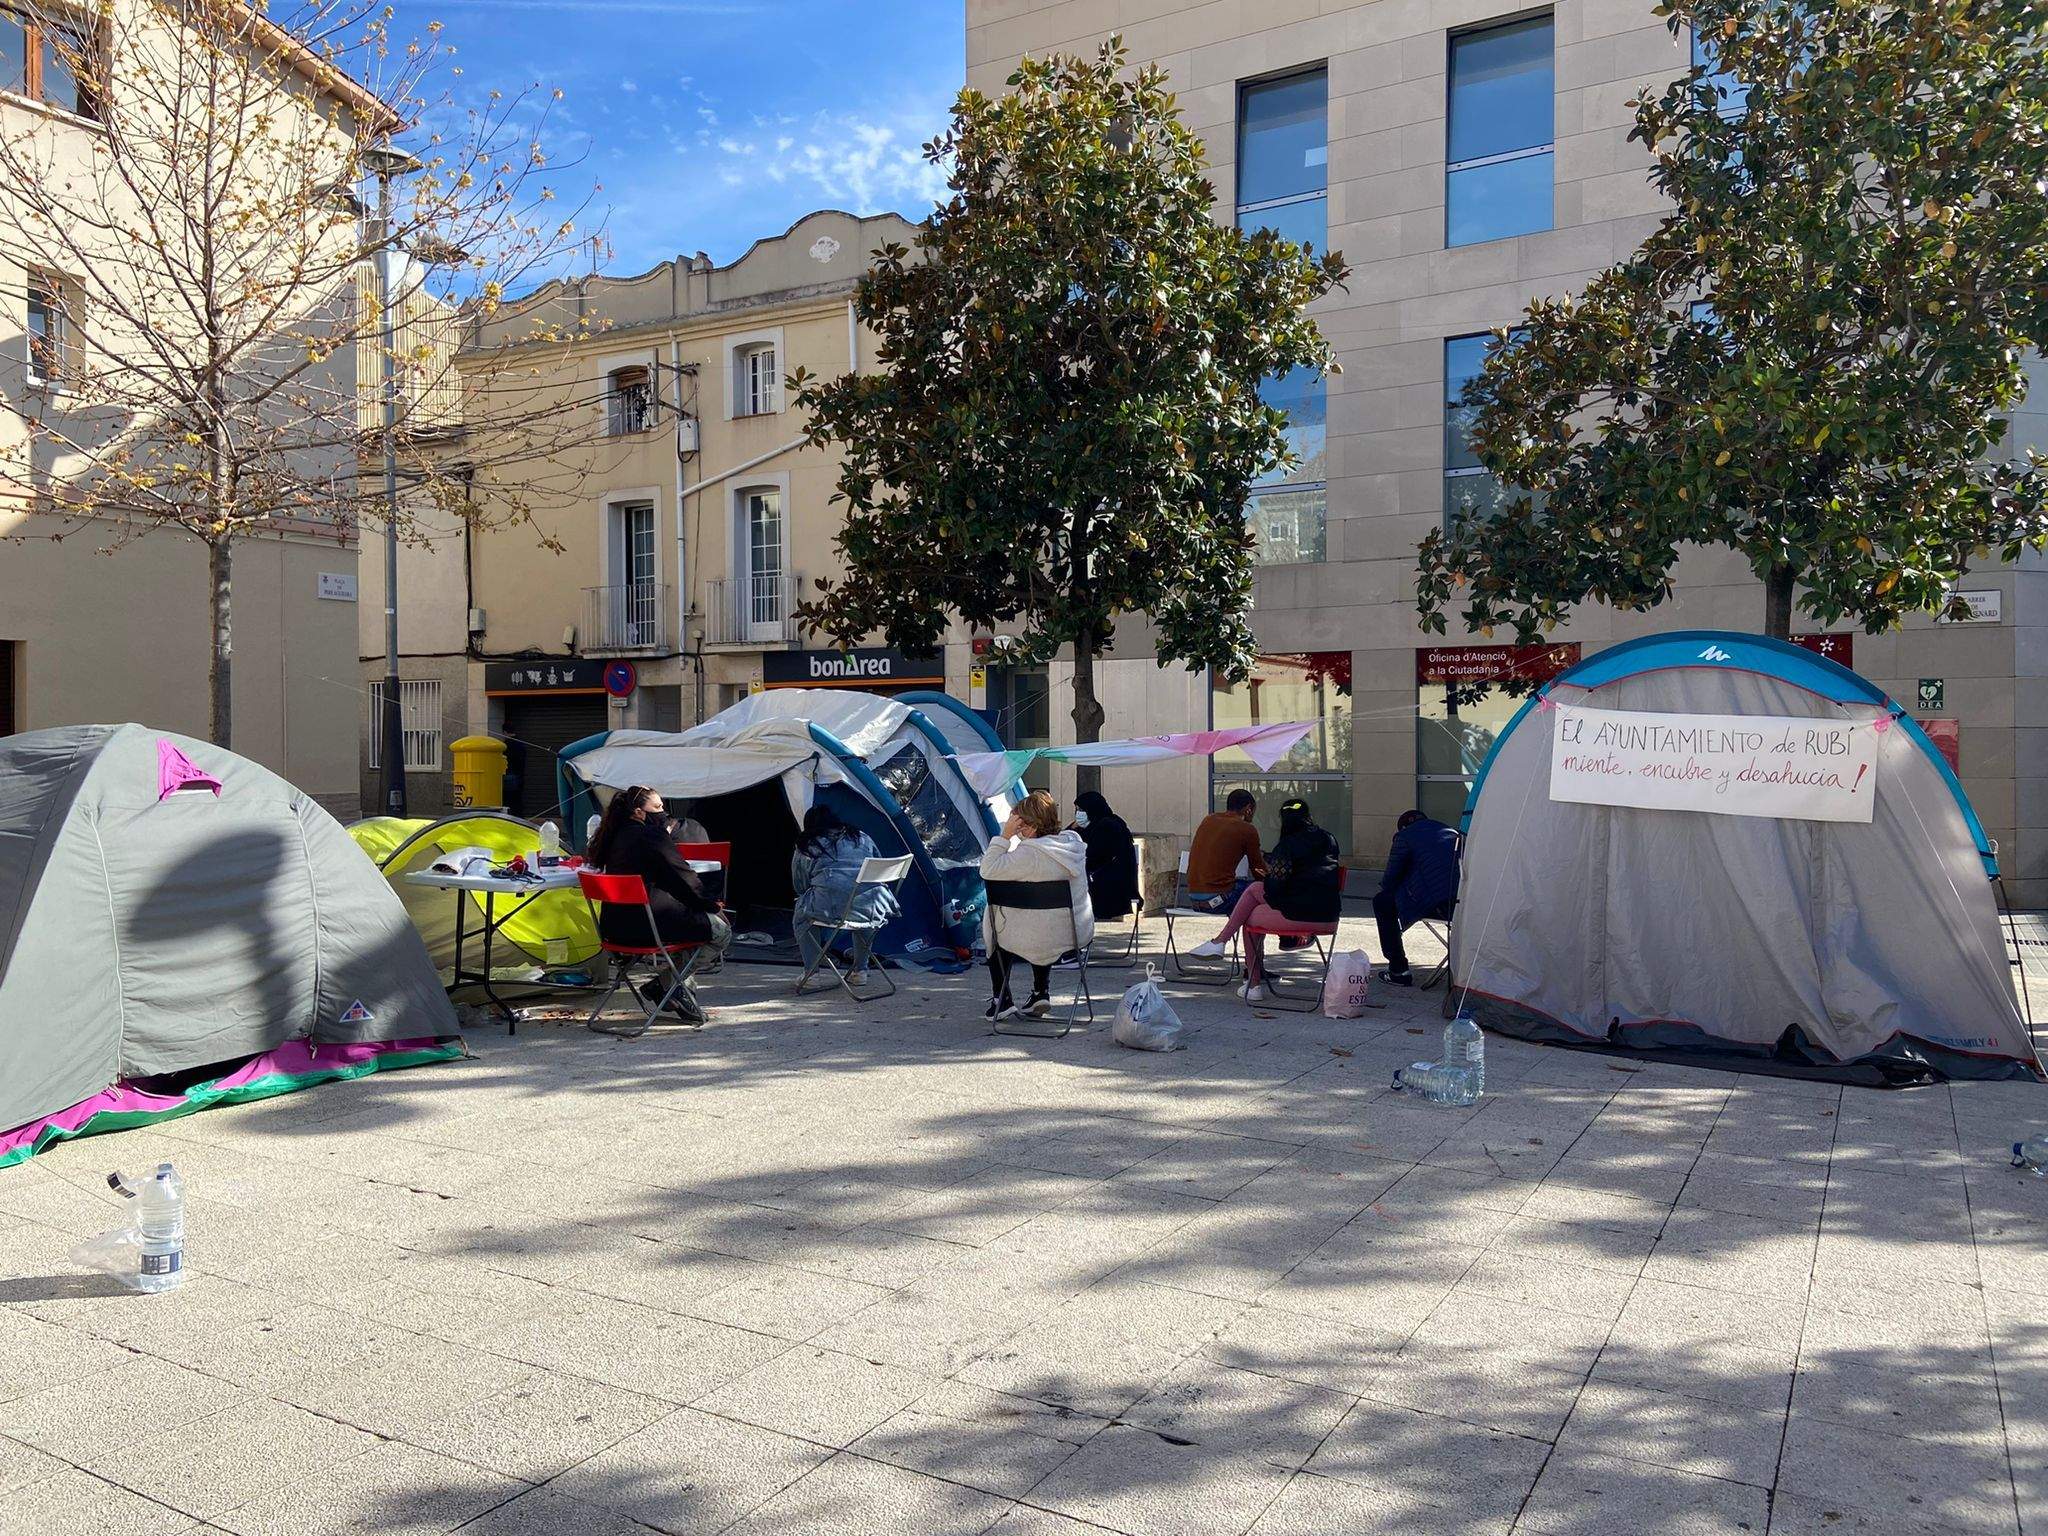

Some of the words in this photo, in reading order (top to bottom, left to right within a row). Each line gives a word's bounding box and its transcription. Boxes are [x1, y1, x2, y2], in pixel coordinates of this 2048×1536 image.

[1428, 653, 1461, 662] Oficina
[1463, 651, 1507, 661] d'Atenció
[1437, 666, 1446, 675] la
[1448, 665, 1500, 675] Ciutadania
[1920, 701, 1942, 709] DEA
[1561, 719, 1584, 744] El
[1593, 721, 1763, 754] AYUNTAMIENTO
[1770, 726, 1796, 754] de
[1804, 727, 1855, 756] RUBÍ
[1640, 756, 1712, 780] encubre
[1715, 771, 1730, 794] y
[1348, 975, 1369, 984] GRA
[1359, 985, 1365, 994] &
